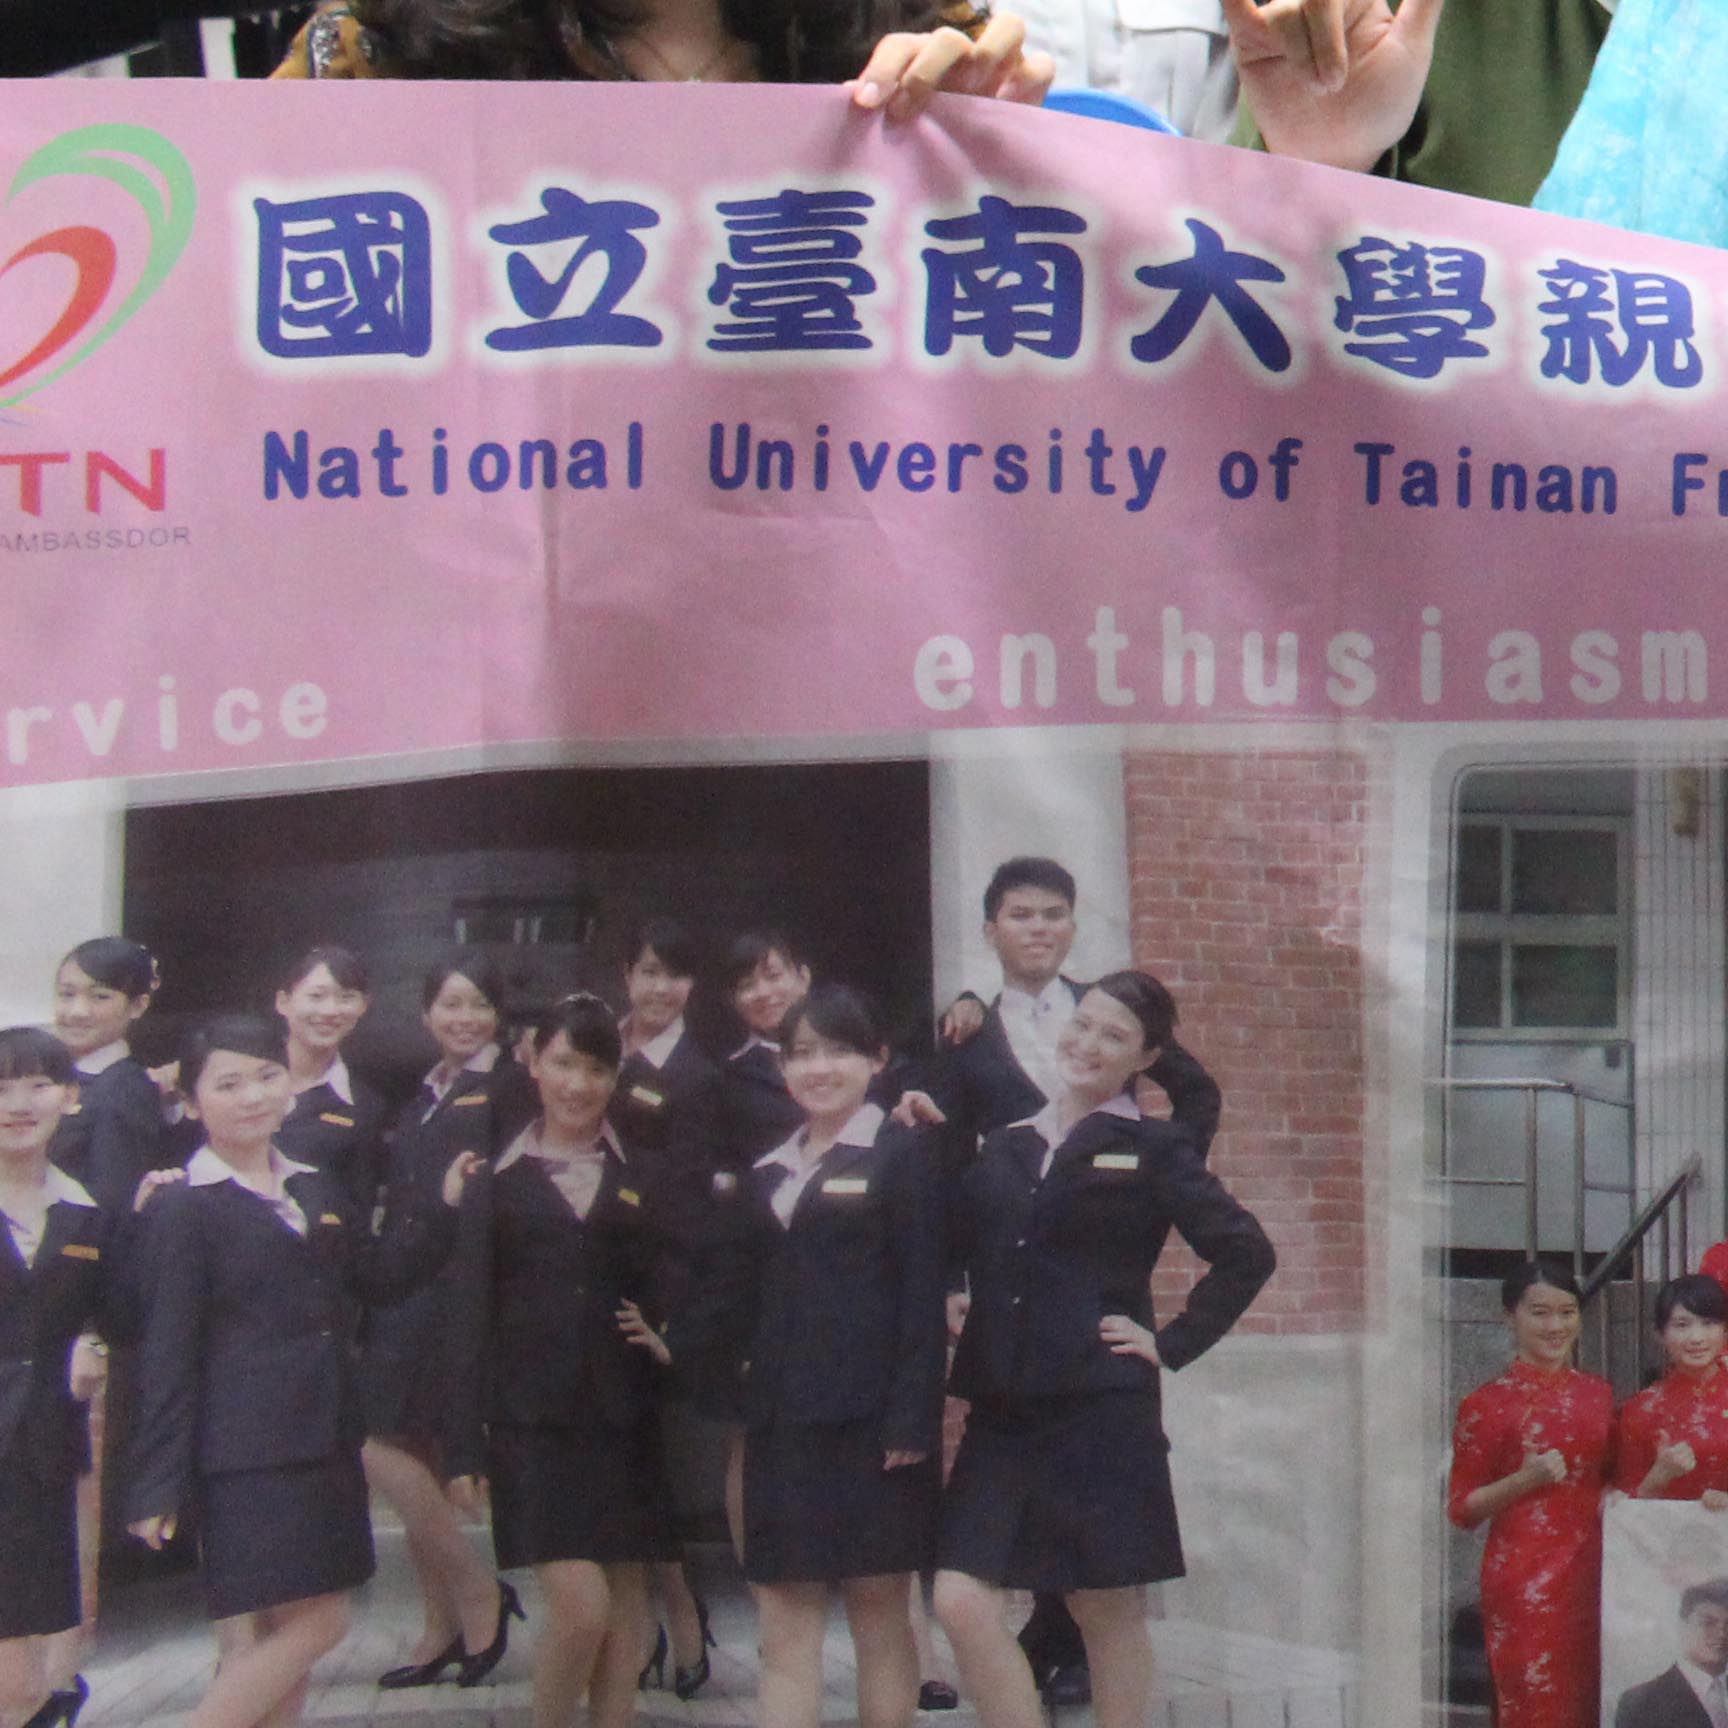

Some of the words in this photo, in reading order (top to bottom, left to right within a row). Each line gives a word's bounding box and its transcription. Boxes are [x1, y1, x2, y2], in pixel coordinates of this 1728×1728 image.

[262, 421, 644, 501] National
[708, 421, 1168, 512] University
[1219, 436, 1304, 502] of
[1353, 441, 1618, 515] Tainan
[913, 605, 1708, 712] enthusiasm
